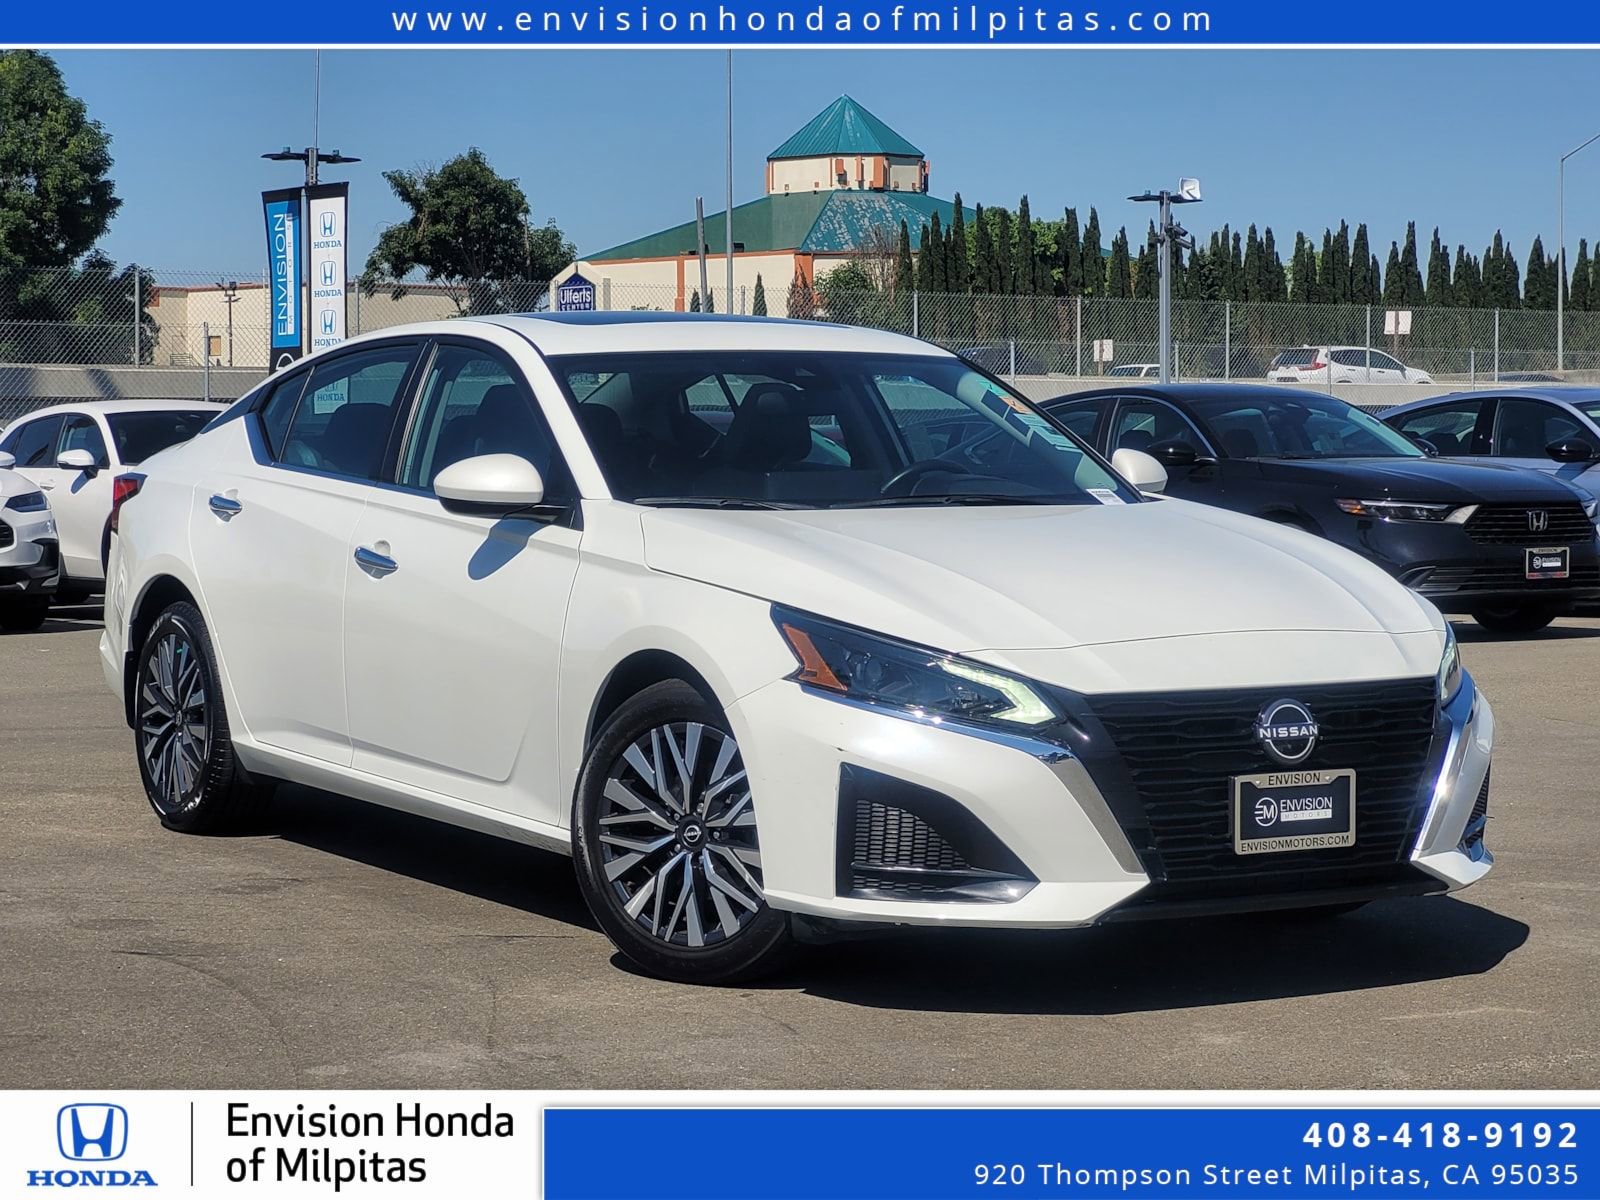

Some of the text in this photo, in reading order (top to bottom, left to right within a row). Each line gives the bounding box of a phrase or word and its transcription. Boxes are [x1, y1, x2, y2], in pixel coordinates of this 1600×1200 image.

[314, 240, 342, 249] HONDA
[274, 213, 287, 336] ENVISION
[314, 289, 342, 298] HONDA
[560, 288, 591, 303] Ulferts
[1260, 725, 1318, 738] NISSAN
[1268, 772, 1321, 786] ENVISION
[1280, 797, 1332, 811] ENVISION
[1284, 811, 1329, 819] MOTORS
[1241, 835, 1350, 852] ENVISIONMOTORS.COM
